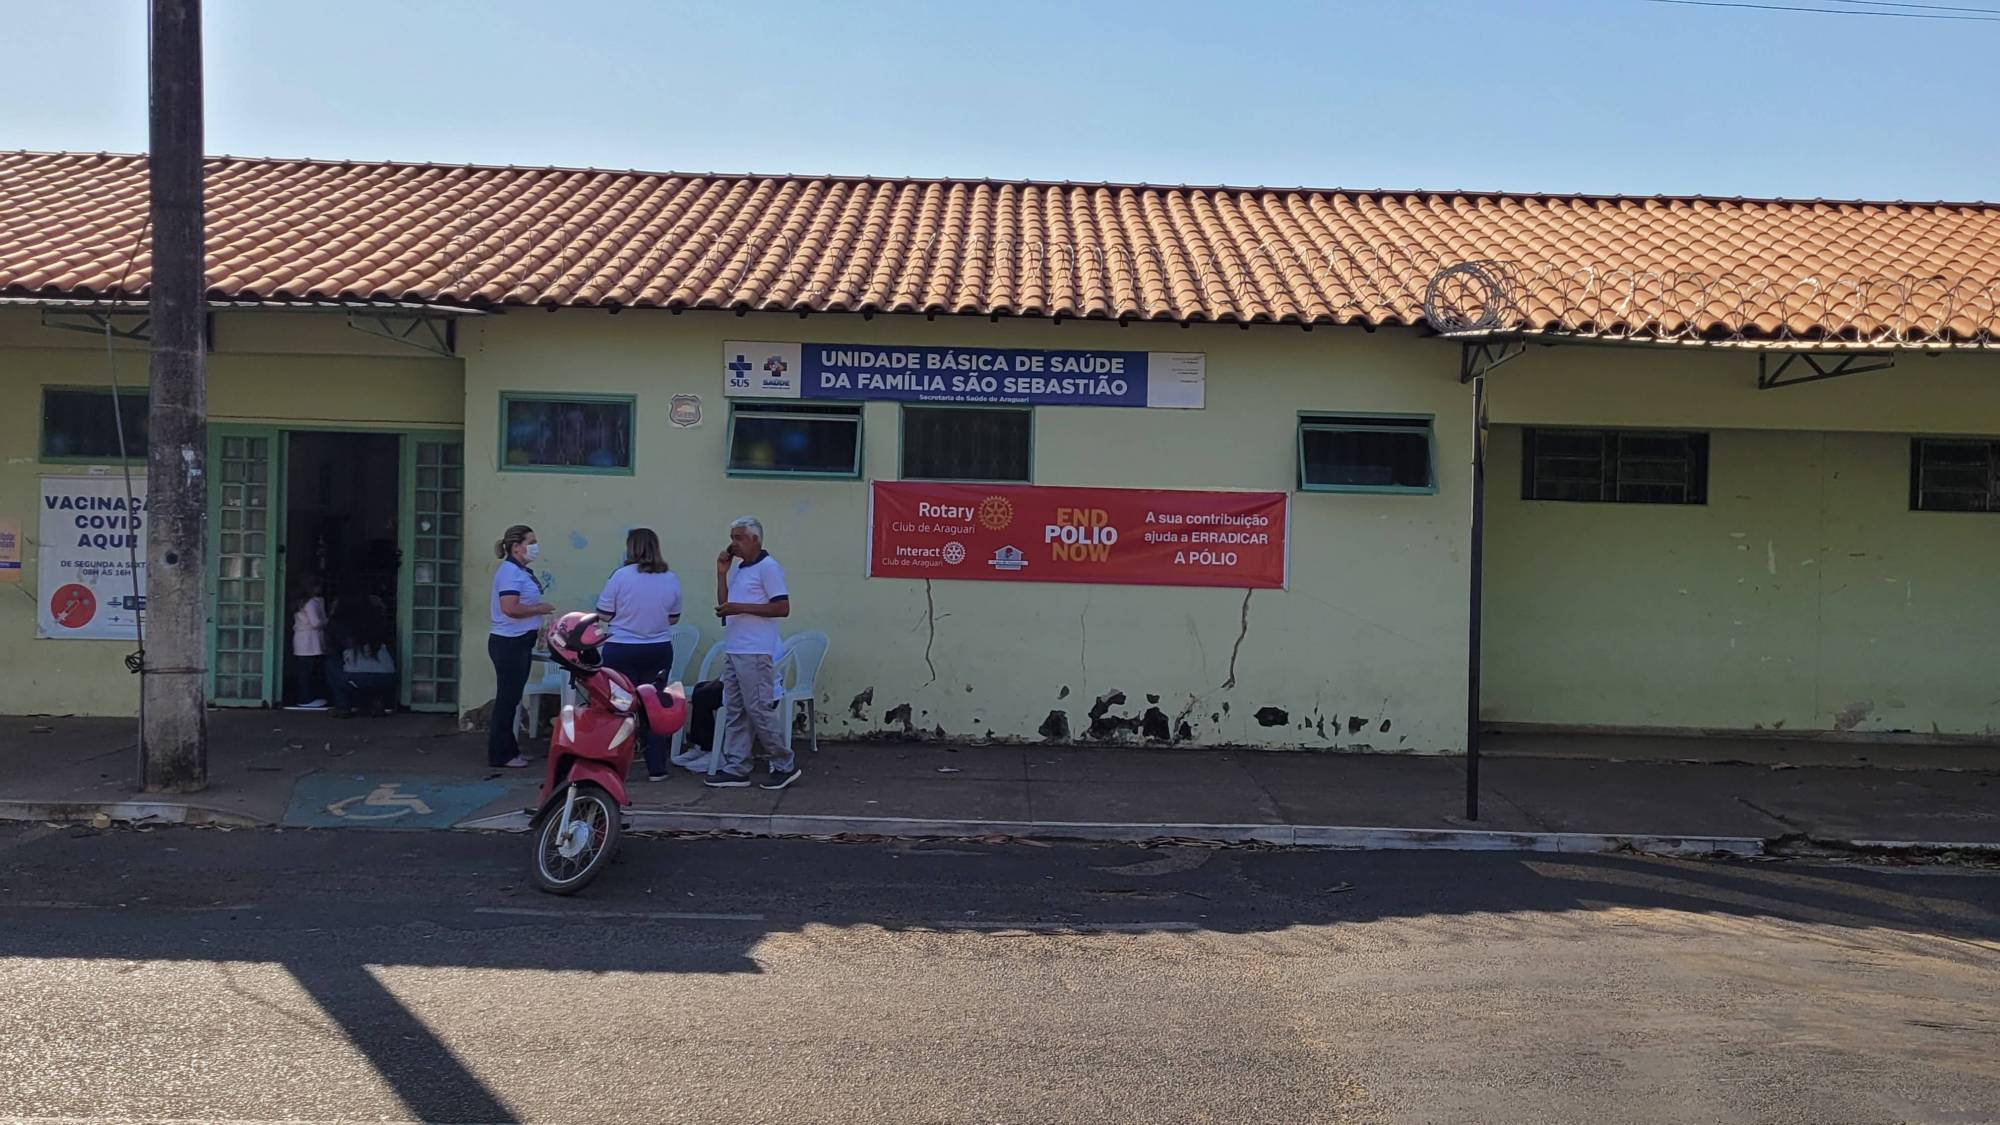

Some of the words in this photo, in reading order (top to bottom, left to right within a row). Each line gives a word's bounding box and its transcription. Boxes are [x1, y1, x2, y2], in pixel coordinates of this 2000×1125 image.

[821, 350, 920, 369] UNIDADE
[926, 350, 1008, 371] BÁSICA
[1015, 355, 1044, 371] DE
[1050, 354, 1124, 373] SAÚDE
[730, 379, 750, 388] SUS
[820, 372, 850, 388] DA
[857, 371, 945, 391] FAMÍLIA
[951, 372, 997, 393] SÃO
[1003, 376, 1127, 396] SEBASTIÃO
[45, 495, 148, 515] VACINAÇ
[919, 502, 974, 522] Rotary
[75, 515, 142, 530] COVID
[1057, 507, 1109, 528] END
[1145, 512, 1156, 524] A
[1159, 514, 1183, 525] sua
[1186, 514, 1269, 529] contribuição
[892, 521, 915, 533] Club
[918, 522, 930, 533] de
[933, 523, 975, 536] Araguari
[1045, 525, 1118, 546] POLIO
[1144, 531, 1178, 545] ajuda
[1181, 534, 1188, 544] a
[1192, 532, 1268, 545] ERRADICAR
[896, 545, 941, 557] Interact
[1052, 542, 1110, 563] NOW
[1174, 551, 1186, 565] A
[1189, 548, 1238, 567] PÓLIO
[60, 560, 72, 568] DE
[74, 560, 114, 569] SEGUNDA
[882, 558, 899, 566] Club
[901, 558, 911, 567] de
[912, 559, 943, 569] Araguari
